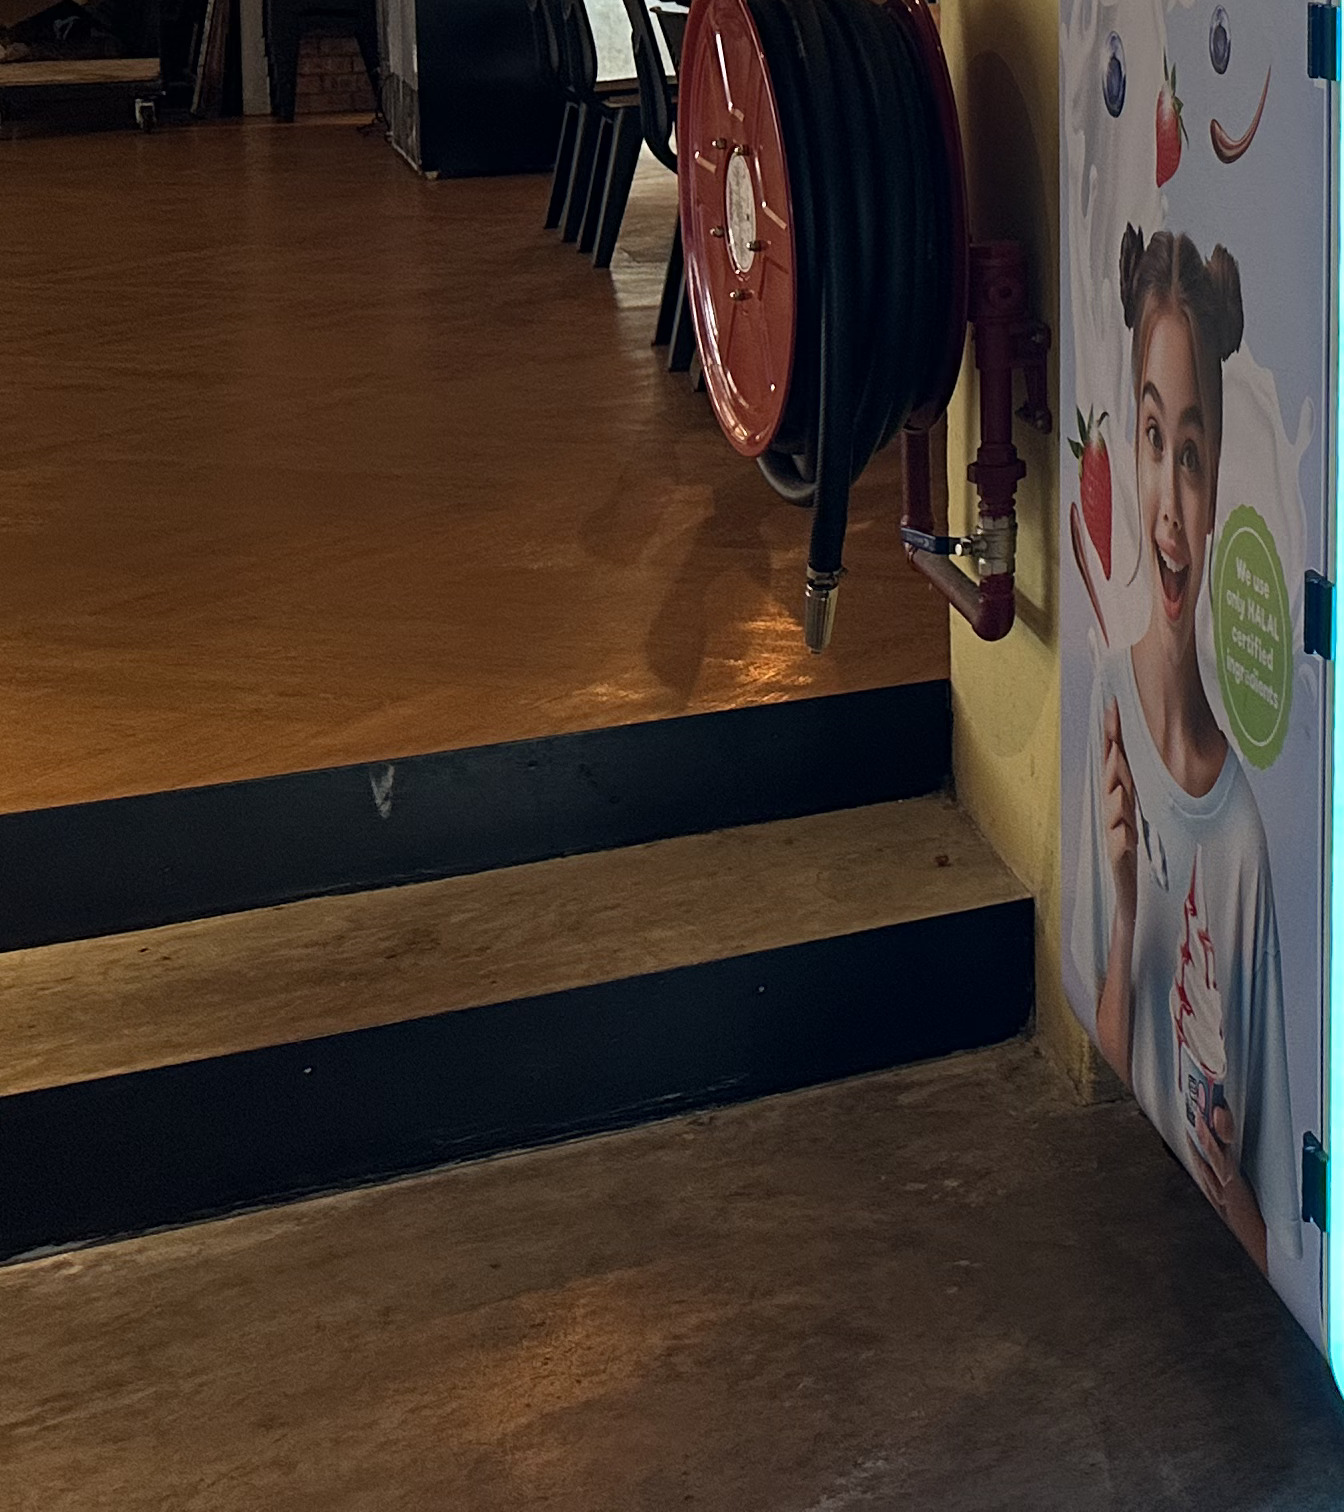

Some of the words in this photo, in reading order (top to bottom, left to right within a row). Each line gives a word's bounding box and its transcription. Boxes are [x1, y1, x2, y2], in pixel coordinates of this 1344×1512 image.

[1235, 556, 1250, 585] We
[1251, 575, 1270, 599] use
[1226, 589, 1245, 620] only
[1247, 597, 1280, 642] HALAL
[1231, 626, 1273, 671] certified
[1226, 648, 1279, 710] ingredients
